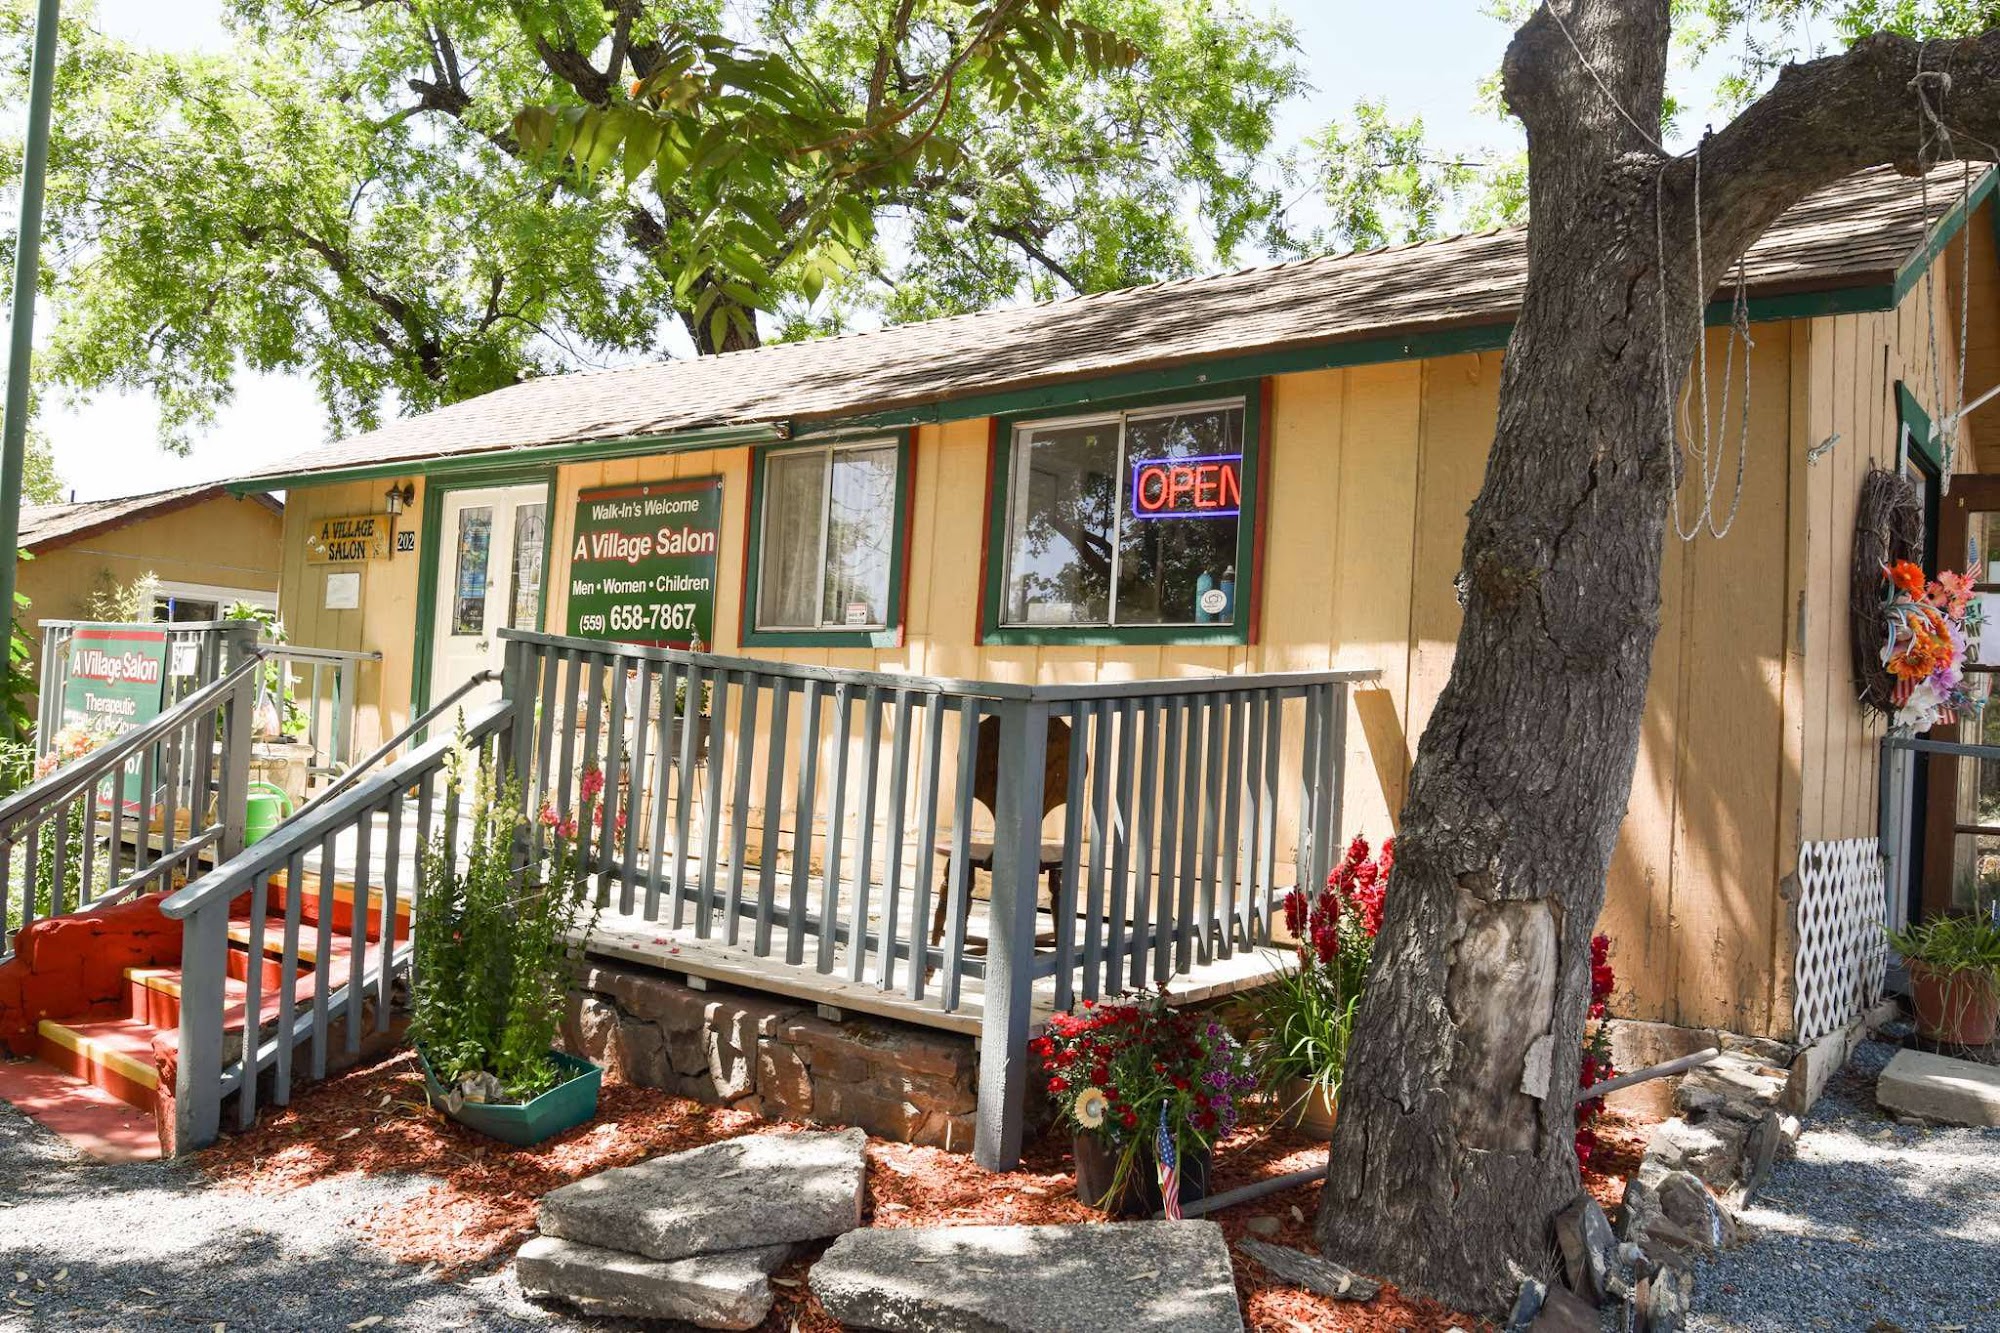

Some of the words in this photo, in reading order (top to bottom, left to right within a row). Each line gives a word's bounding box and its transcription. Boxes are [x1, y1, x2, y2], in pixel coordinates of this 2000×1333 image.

[1138, 464, 1240, 510] OPEN
[592, 502, 641, 521] Walk-In's
[644, 498, 699, 516] Welcome
[321, 522, 329, 540] A
[333, 519, 375, 539] VILLAGE
[397, 532, 415, 550] 202
[328, 540, 366, 561] SALON
[574, 535, 588, 560] A
[592, 532, 651, 563] Village
[656, 527, 715, 555] Salon
[572, 580, 594, 596] Men
[603, 577, 646, 595] Women
[656, 575, 709, 592] Children
[579, 614, 605, 635] (559)
[610, 603, 696, 631] 658-7867
[72, 650, 81, 675] A
[84, 650, 121, 684] Village
[123, 651, 158, 681] Salon
[85, 692, 136, 716] Therapeutic
